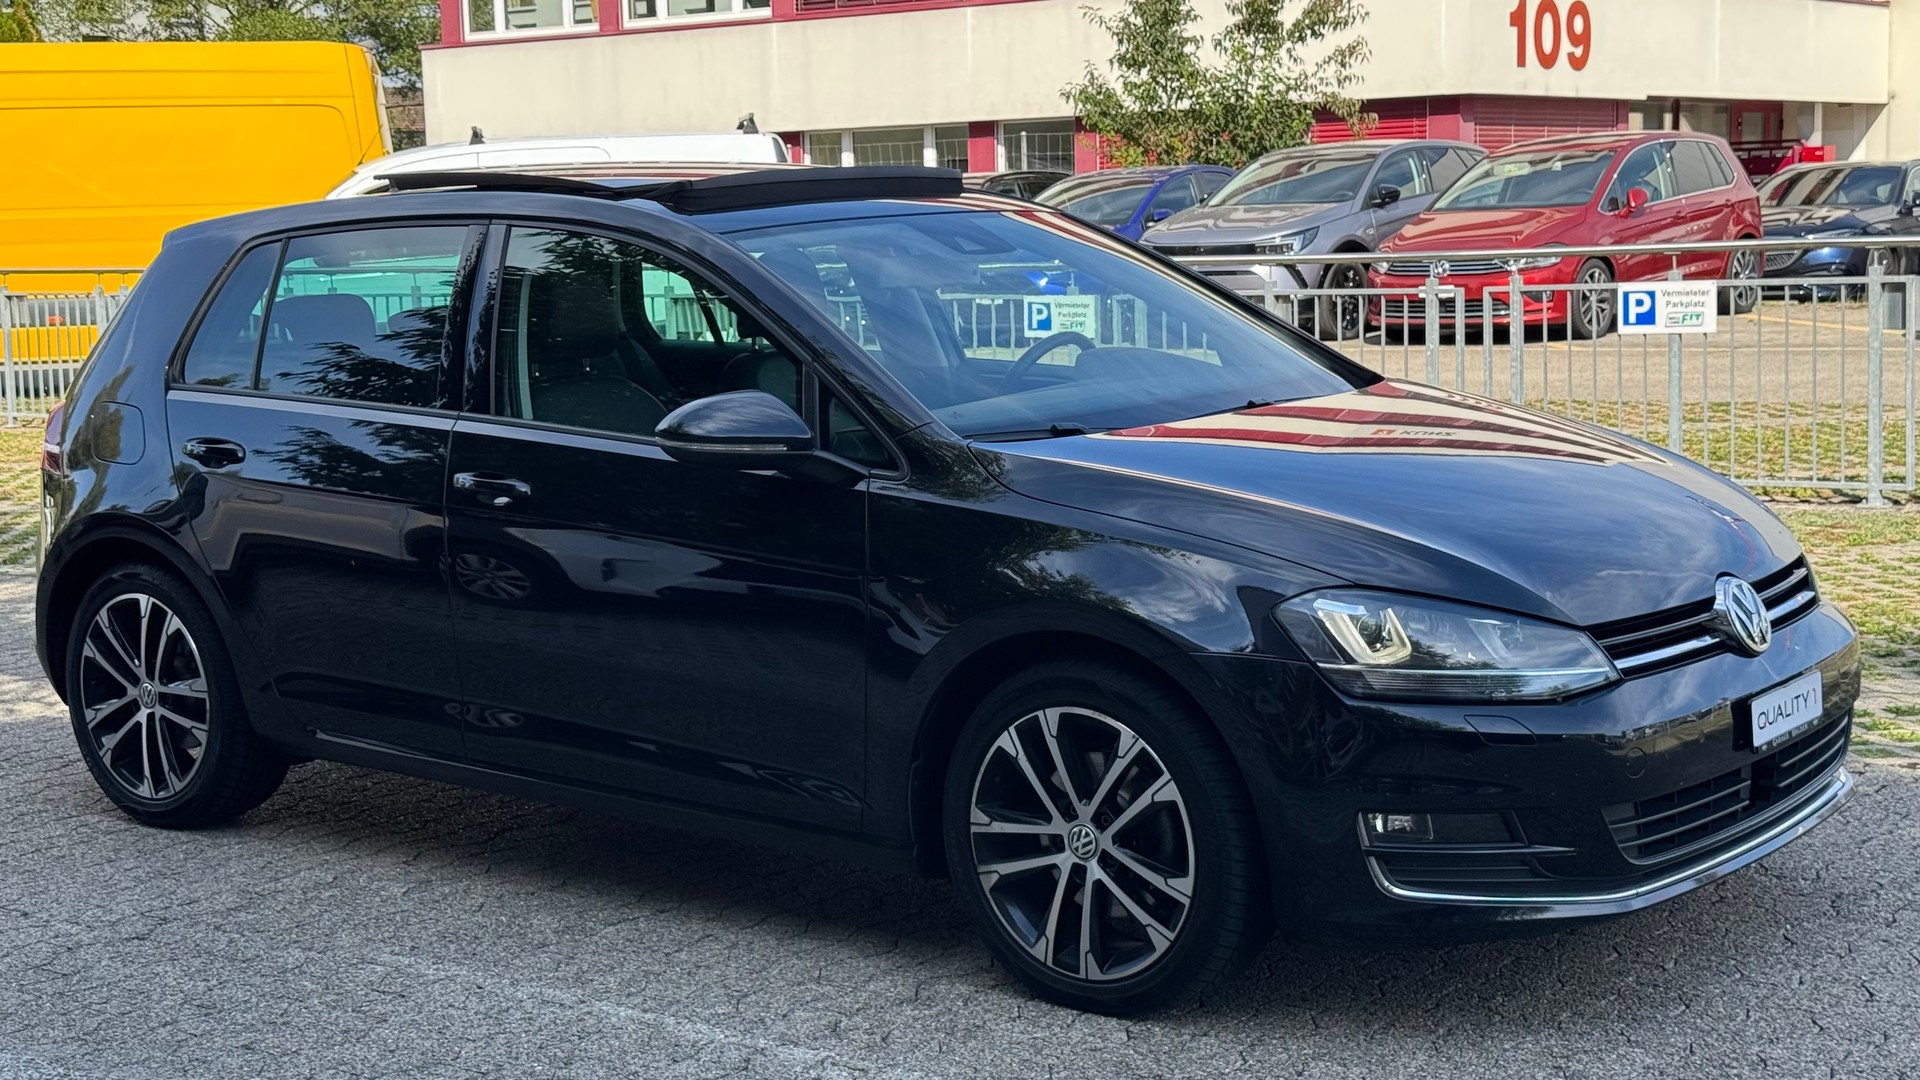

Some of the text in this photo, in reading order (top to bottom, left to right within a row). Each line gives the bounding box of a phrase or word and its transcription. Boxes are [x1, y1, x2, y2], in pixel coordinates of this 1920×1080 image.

[1509, 0, 1591, 71] 109
[1661, 289, 1710, 297] Vermieteter
[1665, 300, 1706, 309] Parkplatz
[1031, 303, 1049, 329] P
[1628, 292, 1652, 324] P
[1681, 313, 1702, 324] FIT
[1757, 688, 1817, 730] QUALITY 1
